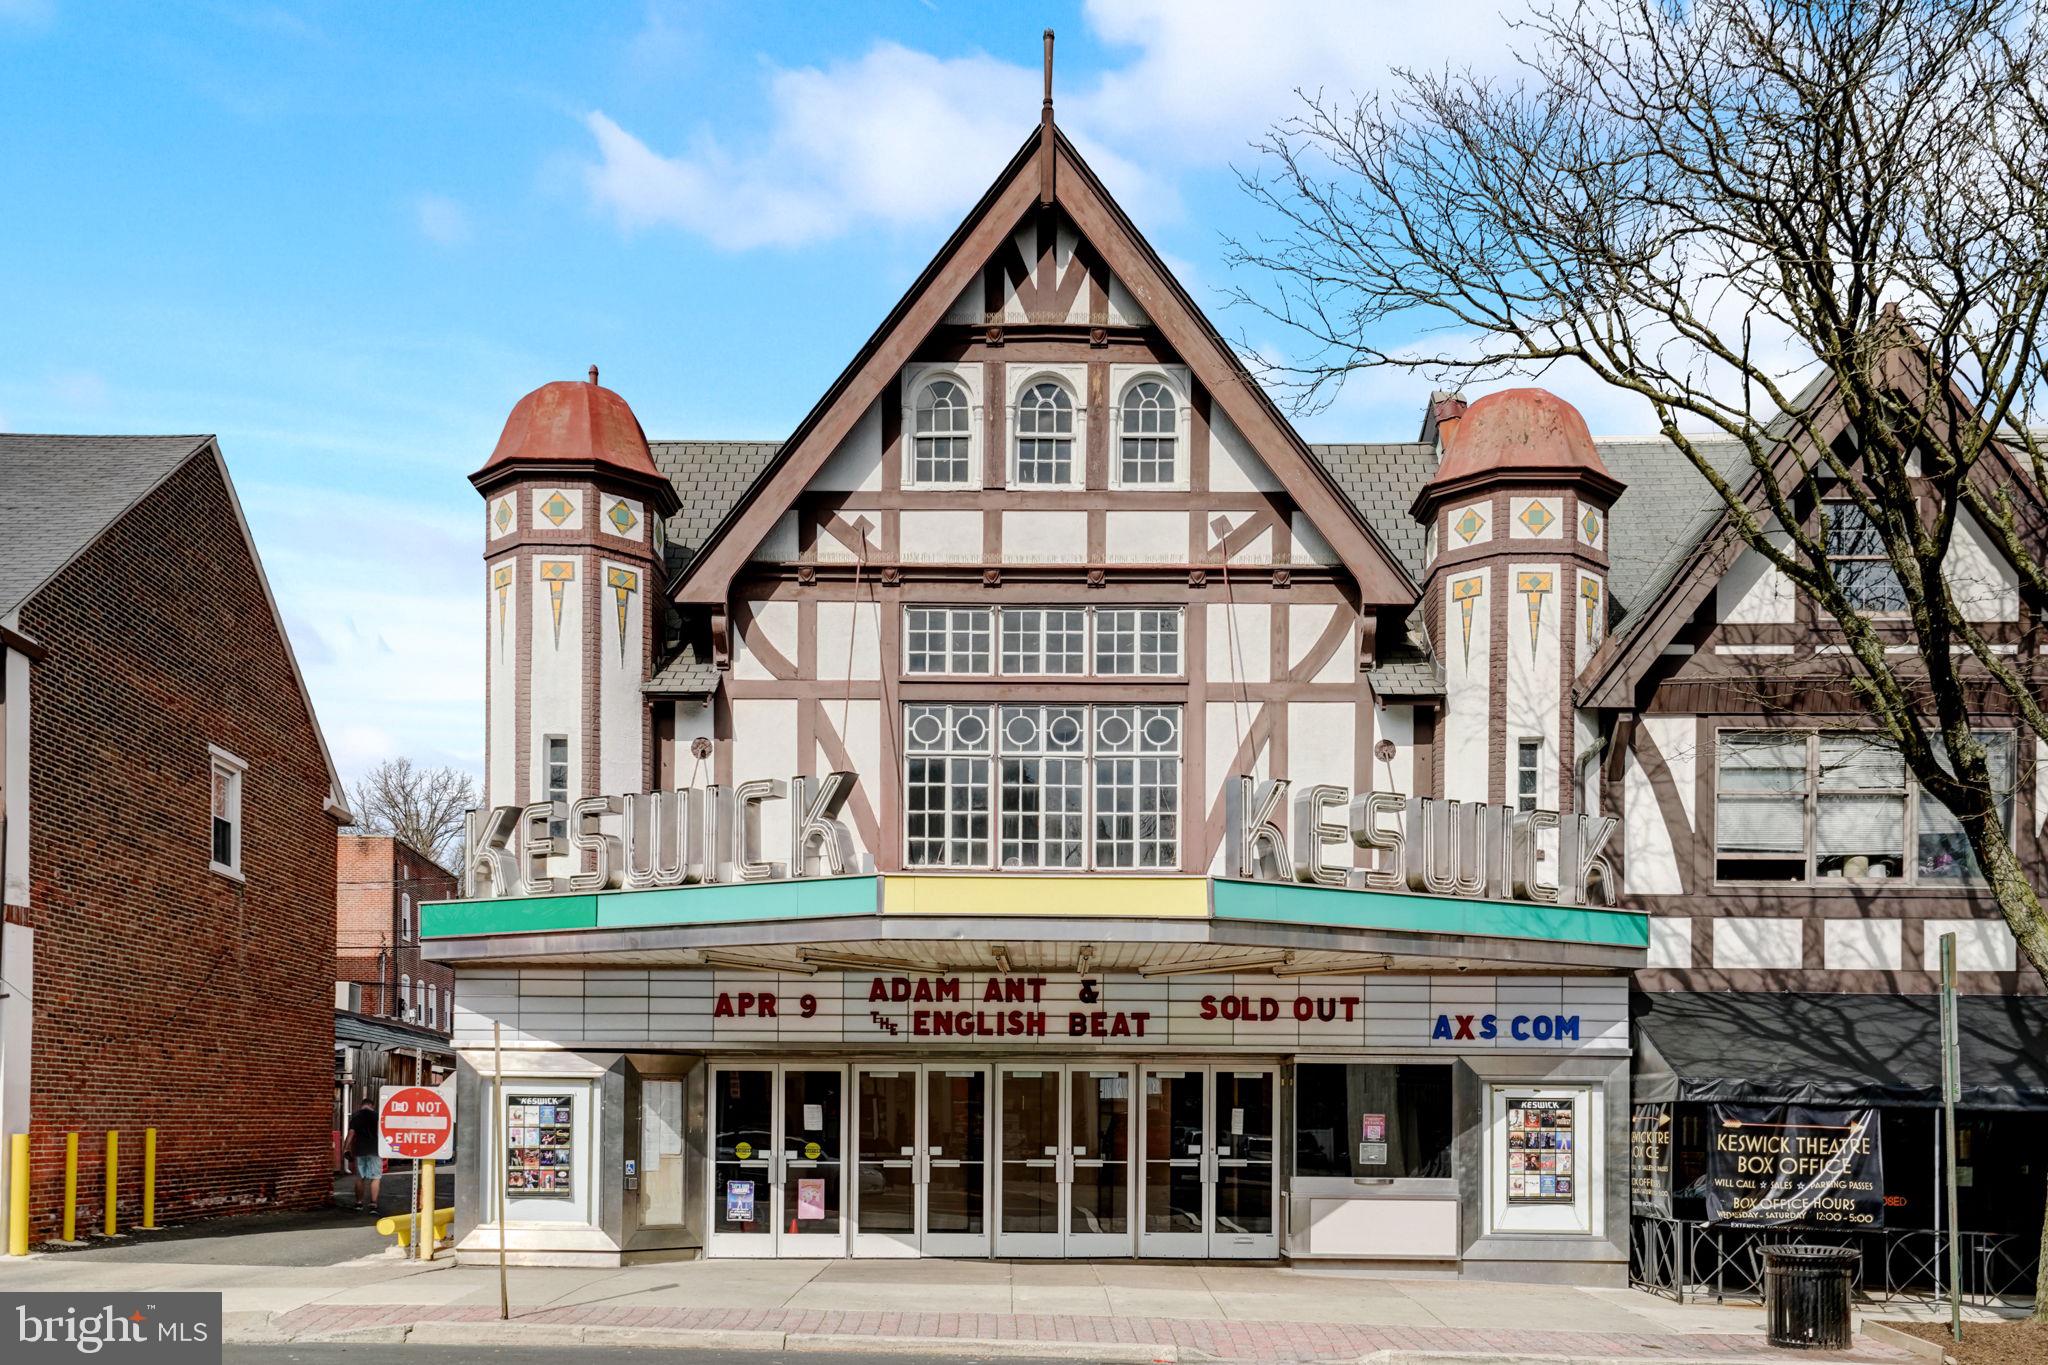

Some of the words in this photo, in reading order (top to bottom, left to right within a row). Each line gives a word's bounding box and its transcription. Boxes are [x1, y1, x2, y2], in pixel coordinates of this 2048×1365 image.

[465, 771, 859, 899] KESWICK
[1226, 774, 1620, 907] KESWICK
[868, 977, 960, 1003] ADAM
[983, 977, 1047, 1003] ANT
[1078, 979, 1100, 1004] &
[713, 992, 778, 1018] APR
[799, 994, 817, 1019] 9
[1199, 995, 1280, 1022] SOLD
[1293, 996, 1360, 1022] OUT
[870, 1011, 898, 1036] THE
[912, 1011, 1047, 1036] ENGLISH
[1068, 1012, 1150, 1037] BEAT
[1432, 1014, 1498, 1040] AXS
[1511, 1015, 1580, 1041] COM
[391, 1101, 409, 1113] DO
[416, 1101, 442, 1113] NOT
[520, 1097, 559, 1105] KESWICK
[1521, 1101, 1560, 1109] KESWICK
[395, 1132, 436, 1144] ENTER
[1717, 1133, 1791, 1154] KESWICK
[1796, 1136, 1871, 1155] THEATRE
[1737, 1155, 1775, 1174] BOX
[1779, 1157, 1852, 1176] OFFICE
[1714, 1178, 1735, 1188] WILL
[1735, 1179, 1756, 1189] CALL
[1770, 1181, 1793, 1190] SALES
[1810, 1180, 1848, 1190] PARKING
[1848, 1181, 1874, 1191] PASSES
[1733, 1197, 1758, 1209] BOX
[1759, 1197, 1809, 1211] OFFICE
[1813, 1196, 1856, 1211] HOURS
[1765, 1211, 1807, 1219] SATURDAY
[1816, 1212, 1842, 1222] 12:00
[1848, 1213, 1874, 1223] 5:00
